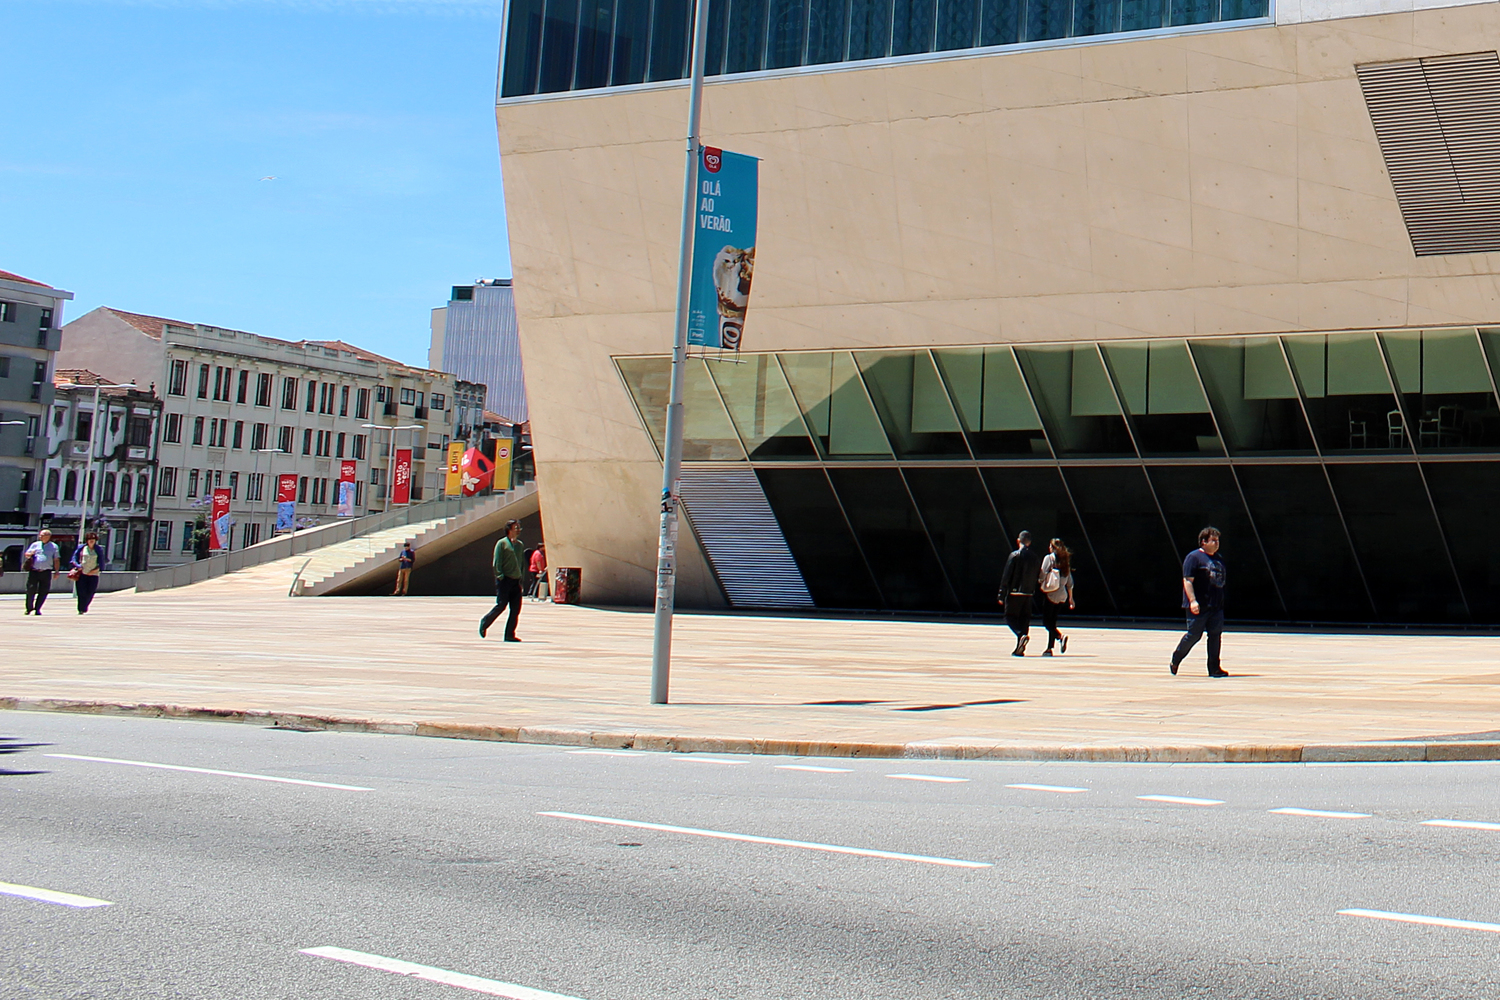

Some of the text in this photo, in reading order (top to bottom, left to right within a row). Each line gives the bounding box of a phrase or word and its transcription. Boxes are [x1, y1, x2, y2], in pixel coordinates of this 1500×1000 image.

[702, 180, 722, 197] OLÁ
[701, 197, 714, 213] AO
[700, 214, 734, 233] VERÃO.
